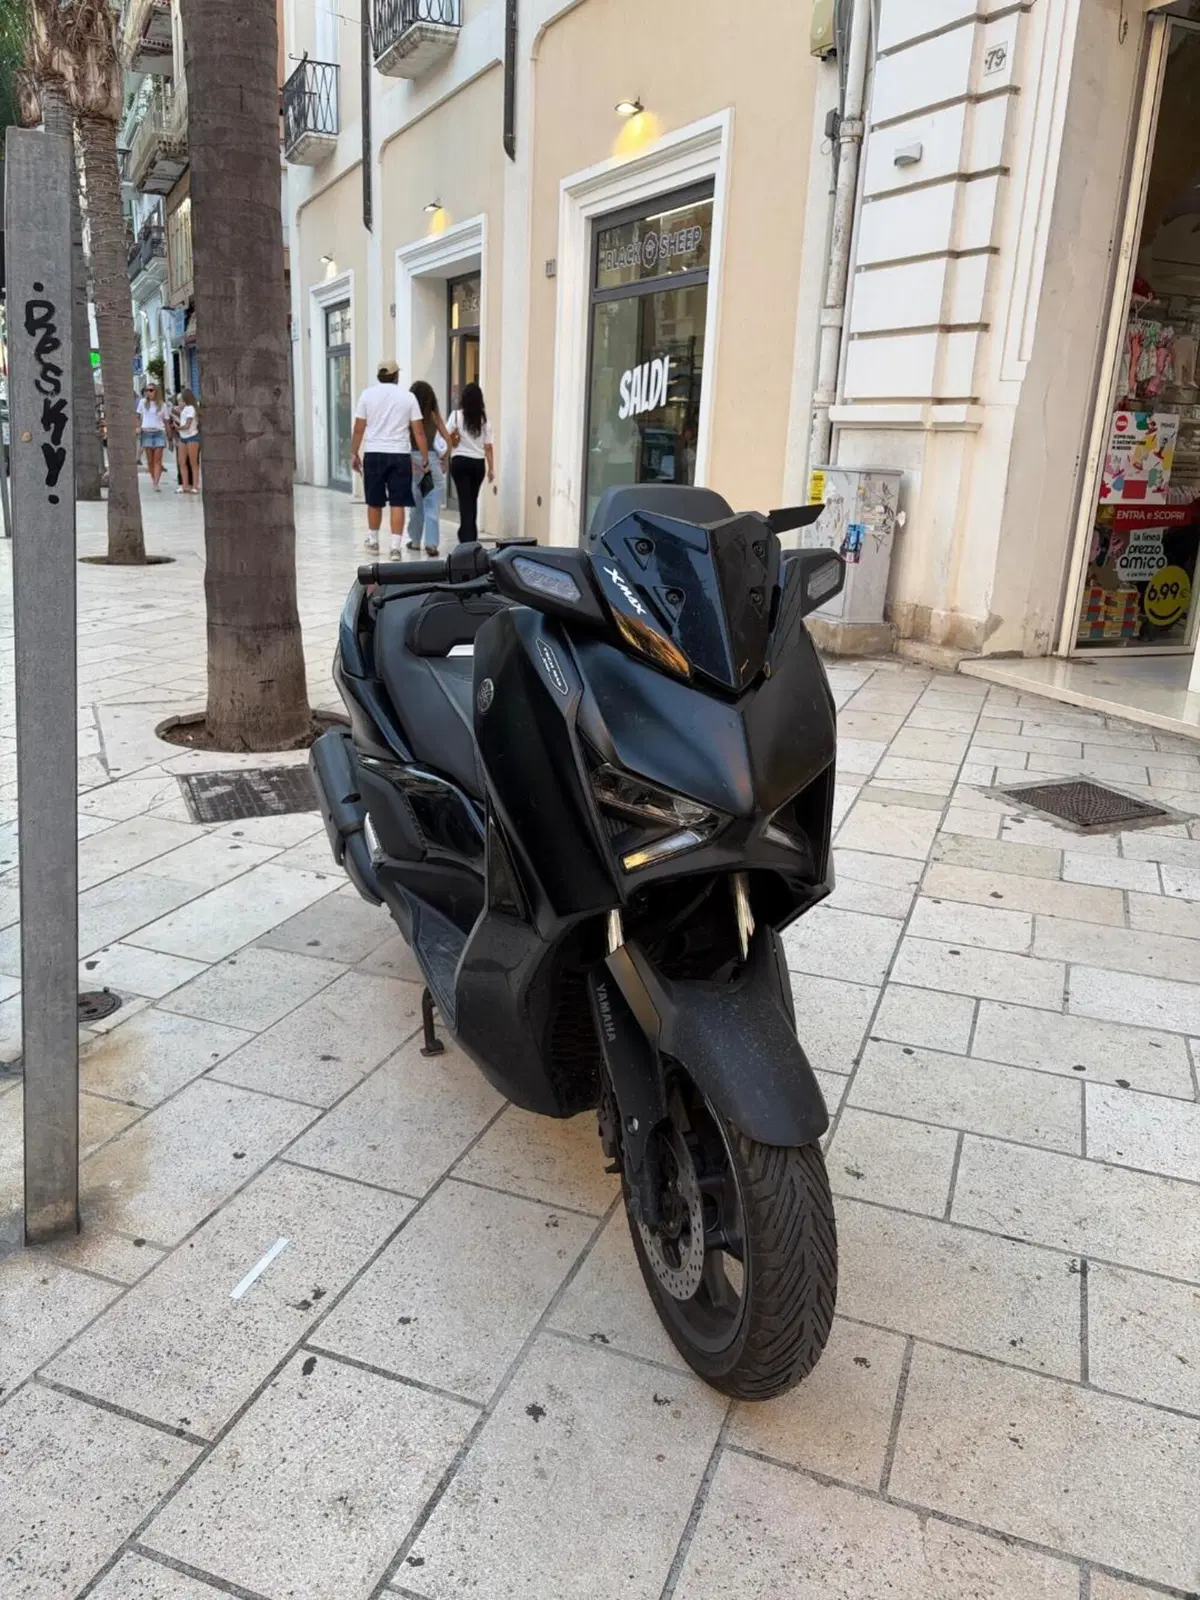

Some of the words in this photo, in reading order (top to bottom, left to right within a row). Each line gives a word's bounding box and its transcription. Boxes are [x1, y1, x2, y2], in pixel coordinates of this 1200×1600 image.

[605, 242, 641, 272] BLACK
[659, 225, 702, 259] SHEEP
[618, 354, 670, 420] SALDI
[1116, 510, 1145, 520] ENTRA
[1153, 511, 1185, 520] SCOPRI
[1128, 544, 1162, 556] prezzo
[1142, 531, 1160, 541] linea
[1119, 556, 1166, 570] amico
[602, 566, 647, 615] XMAX
[595, 982, 617, 1042] YAMAHA
